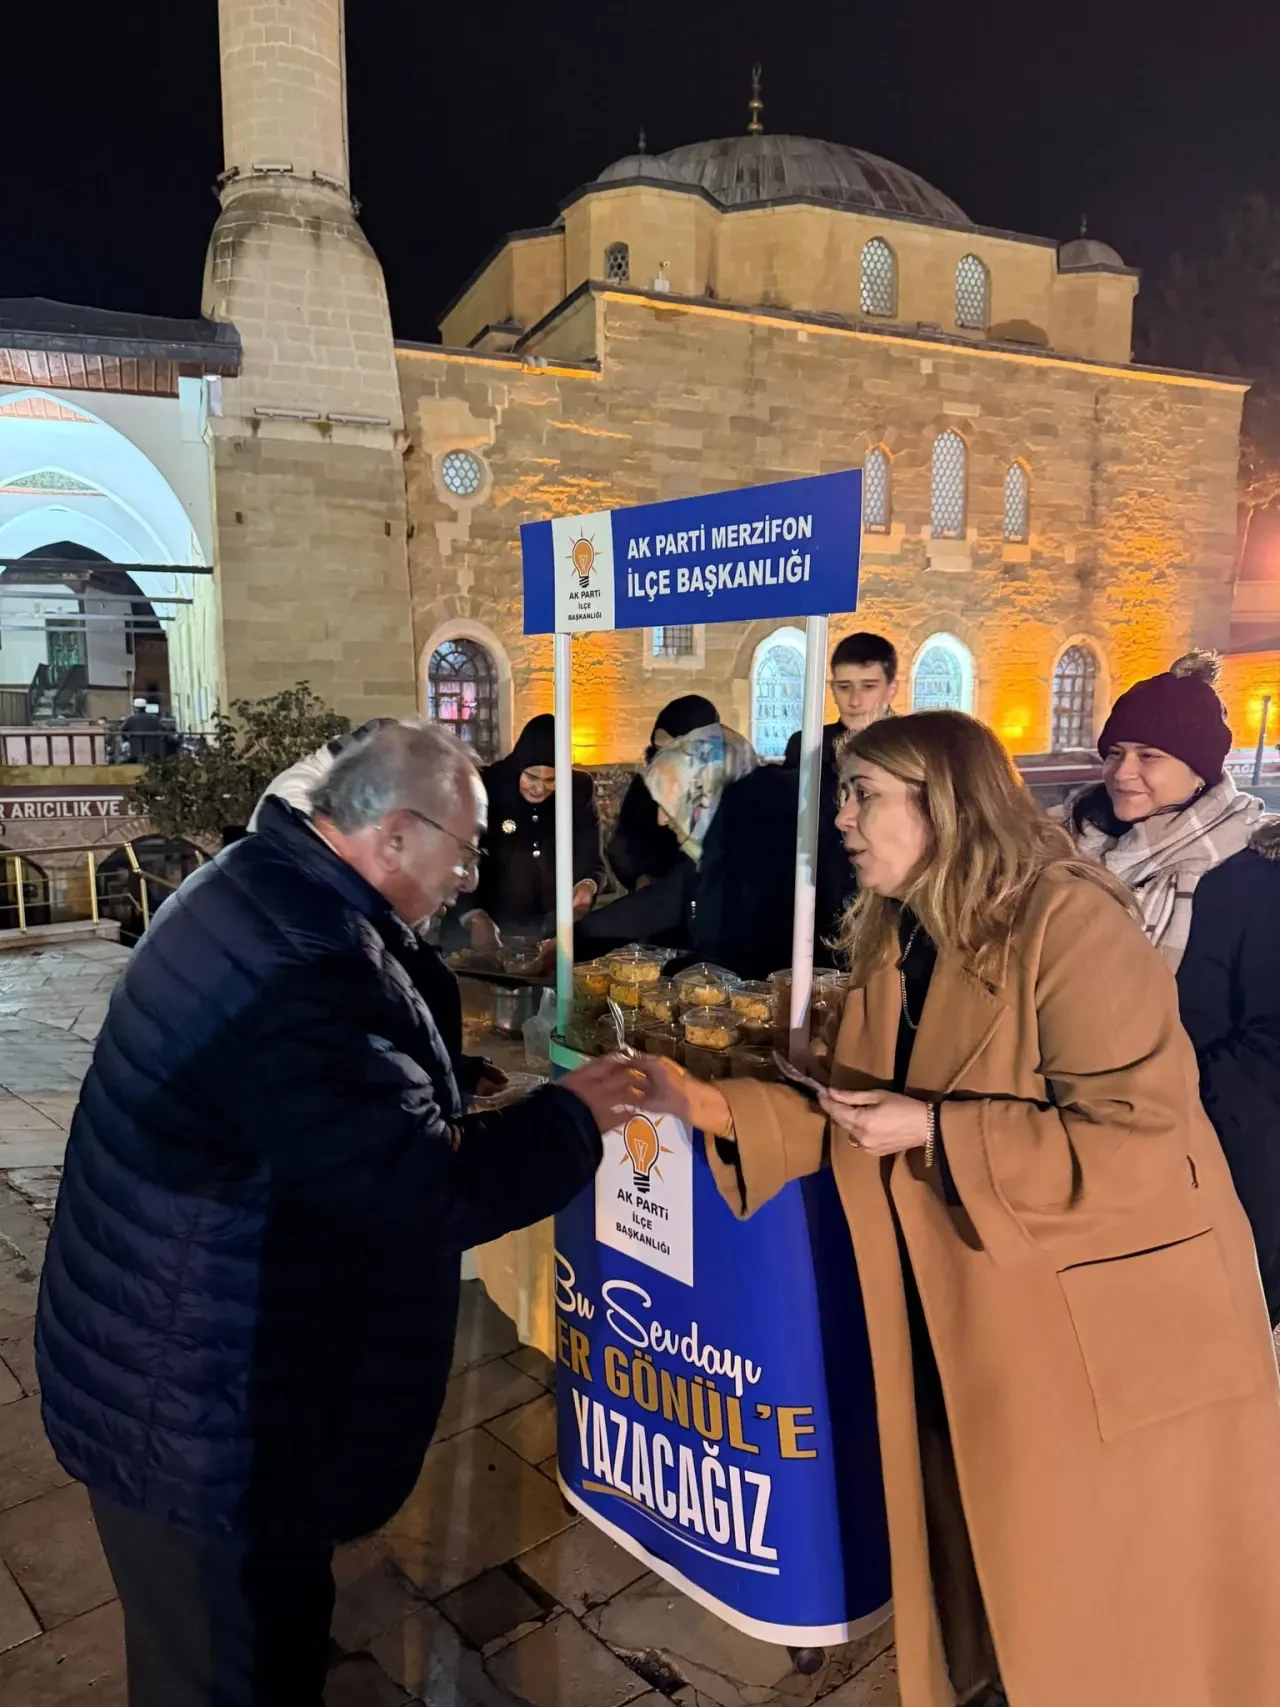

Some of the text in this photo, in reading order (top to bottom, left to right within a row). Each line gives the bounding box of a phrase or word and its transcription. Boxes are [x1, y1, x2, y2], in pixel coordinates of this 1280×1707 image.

[627, 515, 813, 560] AK PARTİ MERZİFON
[628, 549, 811, 602] İLÇE BAŞKANLIĞI
[569, 592, 580, 600] AK
[578, 601, 592, 611] İLÇE
[567, 611, 602, 621] BAŞKANLIĞI
[11, 801, 92, 818] ARICILIK
[96, 800, 120, 816] VE
[617, 1188, 634, 1205] AK
[632, 1211, 653, 1231] İLÇE
[615, 1222, 671, 1256] BAŞKANLIĞI
[554, 1248, 763, 1397] Bu Sevdayı
[571, 1387, 778, 1561] YAZACAĞIZ
